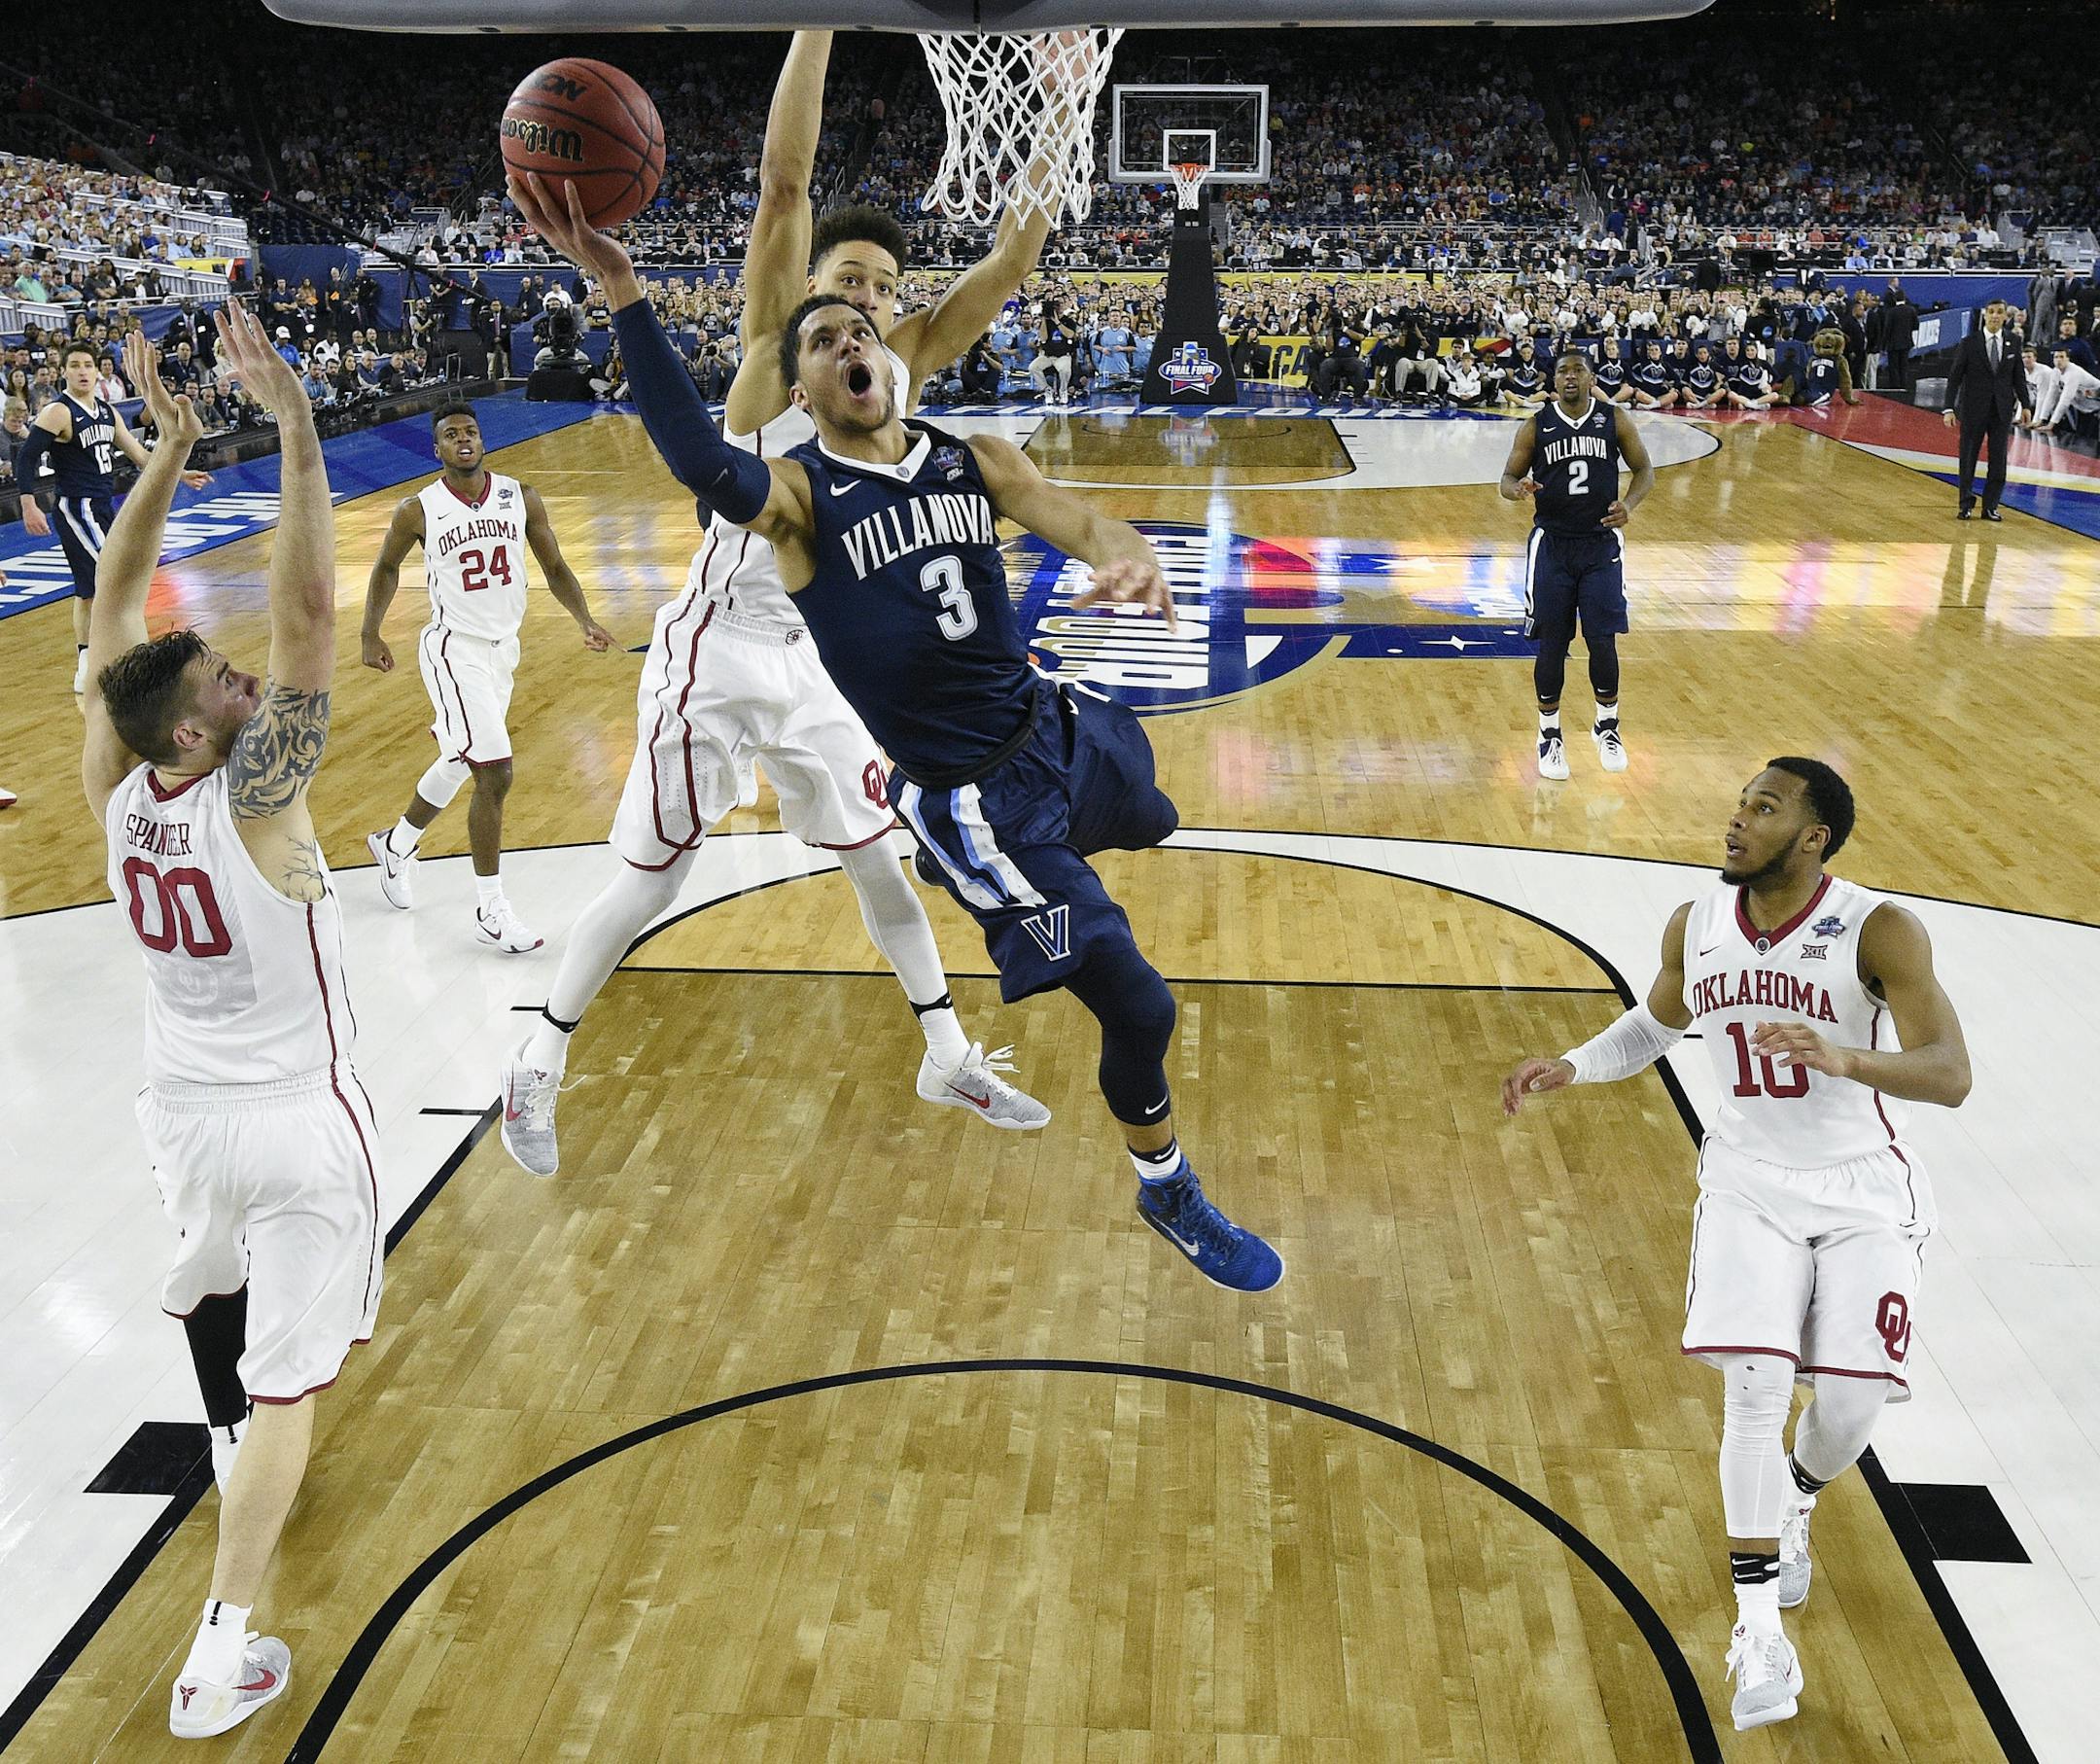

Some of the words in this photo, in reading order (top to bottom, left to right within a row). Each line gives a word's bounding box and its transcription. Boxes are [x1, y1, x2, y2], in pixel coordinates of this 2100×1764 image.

[94, 443, 112, 475] 15
[1544, 436, 1607, 465] VILLANOVA
[1568, 460, 1589, 495] 2
[438, 519, 518, 556] OKLAHOMA
[840, 494, 994, 582] VILLANOVA
[459, 545, 511, 592] 24
[920, 554, 978, 642] 3
[122, 857, 233, 958] 00
[1021, 903, 1072, 962] V
[1693, 970, 1838, 1024] OKLAHOMA
